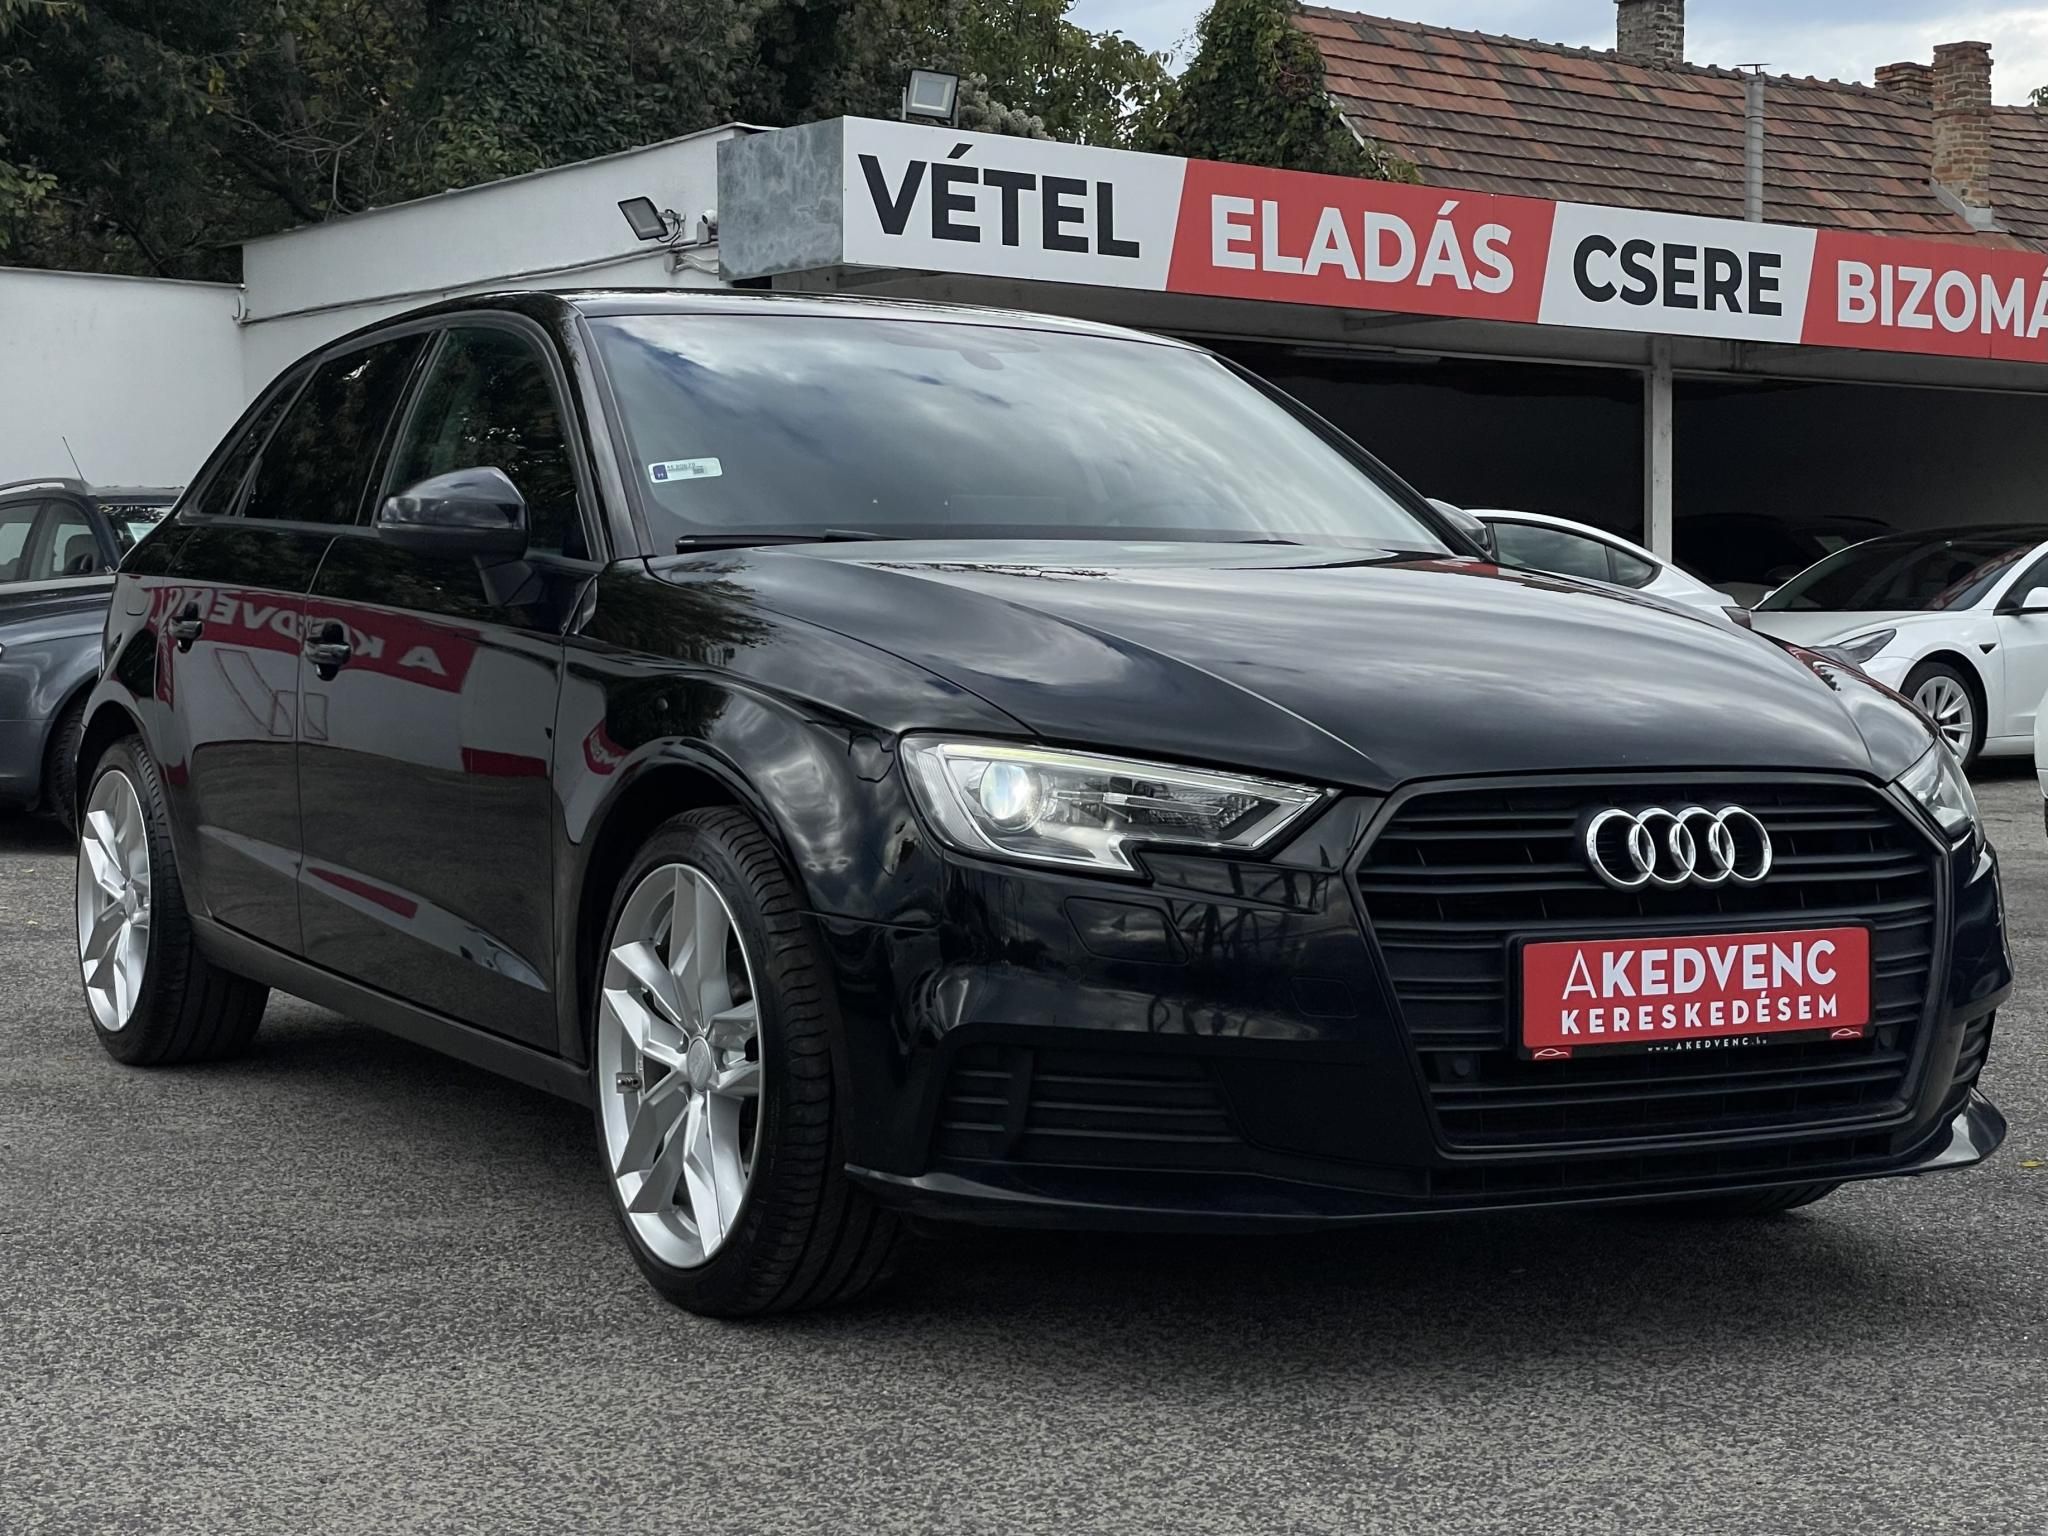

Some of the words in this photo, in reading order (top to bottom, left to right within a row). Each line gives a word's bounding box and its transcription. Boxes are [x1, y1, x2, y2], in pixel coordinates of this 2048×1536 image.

[858, 142, 1140, 259] VÉTEL
[1211, 193, 1515, 294] ELADÁS
[1572, 233, 1783, 318] CSERE
[1562, 939, 1837, 1000] AKEDVENC
[1561, 991, 1837, 1036] KERESKEDÉSEM
